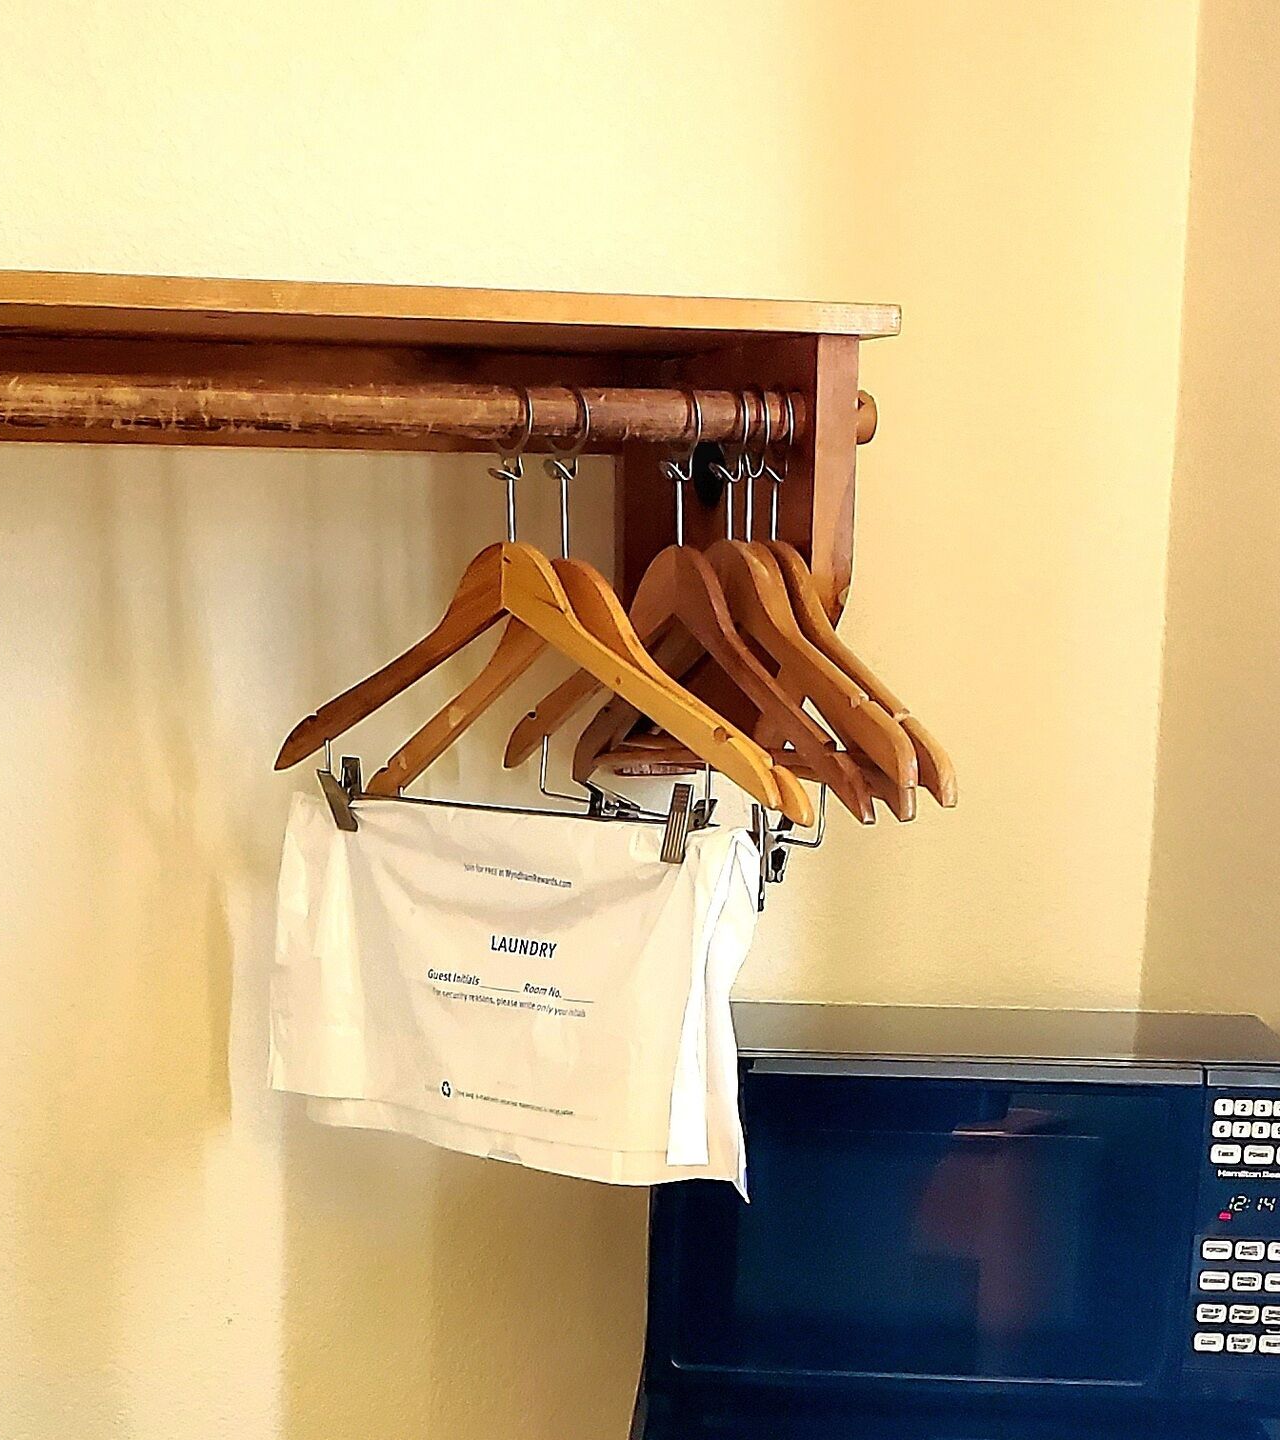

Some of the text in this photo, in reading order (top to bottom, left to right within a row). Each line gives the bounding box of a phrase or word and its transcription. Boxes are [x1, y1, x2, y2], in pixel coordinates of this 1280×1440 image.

[490, 935, 557, 958] LAUNDRY
[427, 968, 562, 999] Guest Initials Room No.
[442, 989, 467, 1002] security
[496, 997, 518, 1009] please
[536, 1003, 554, 1014] only
[1228, 1195, 1277, 1211] 12:14
